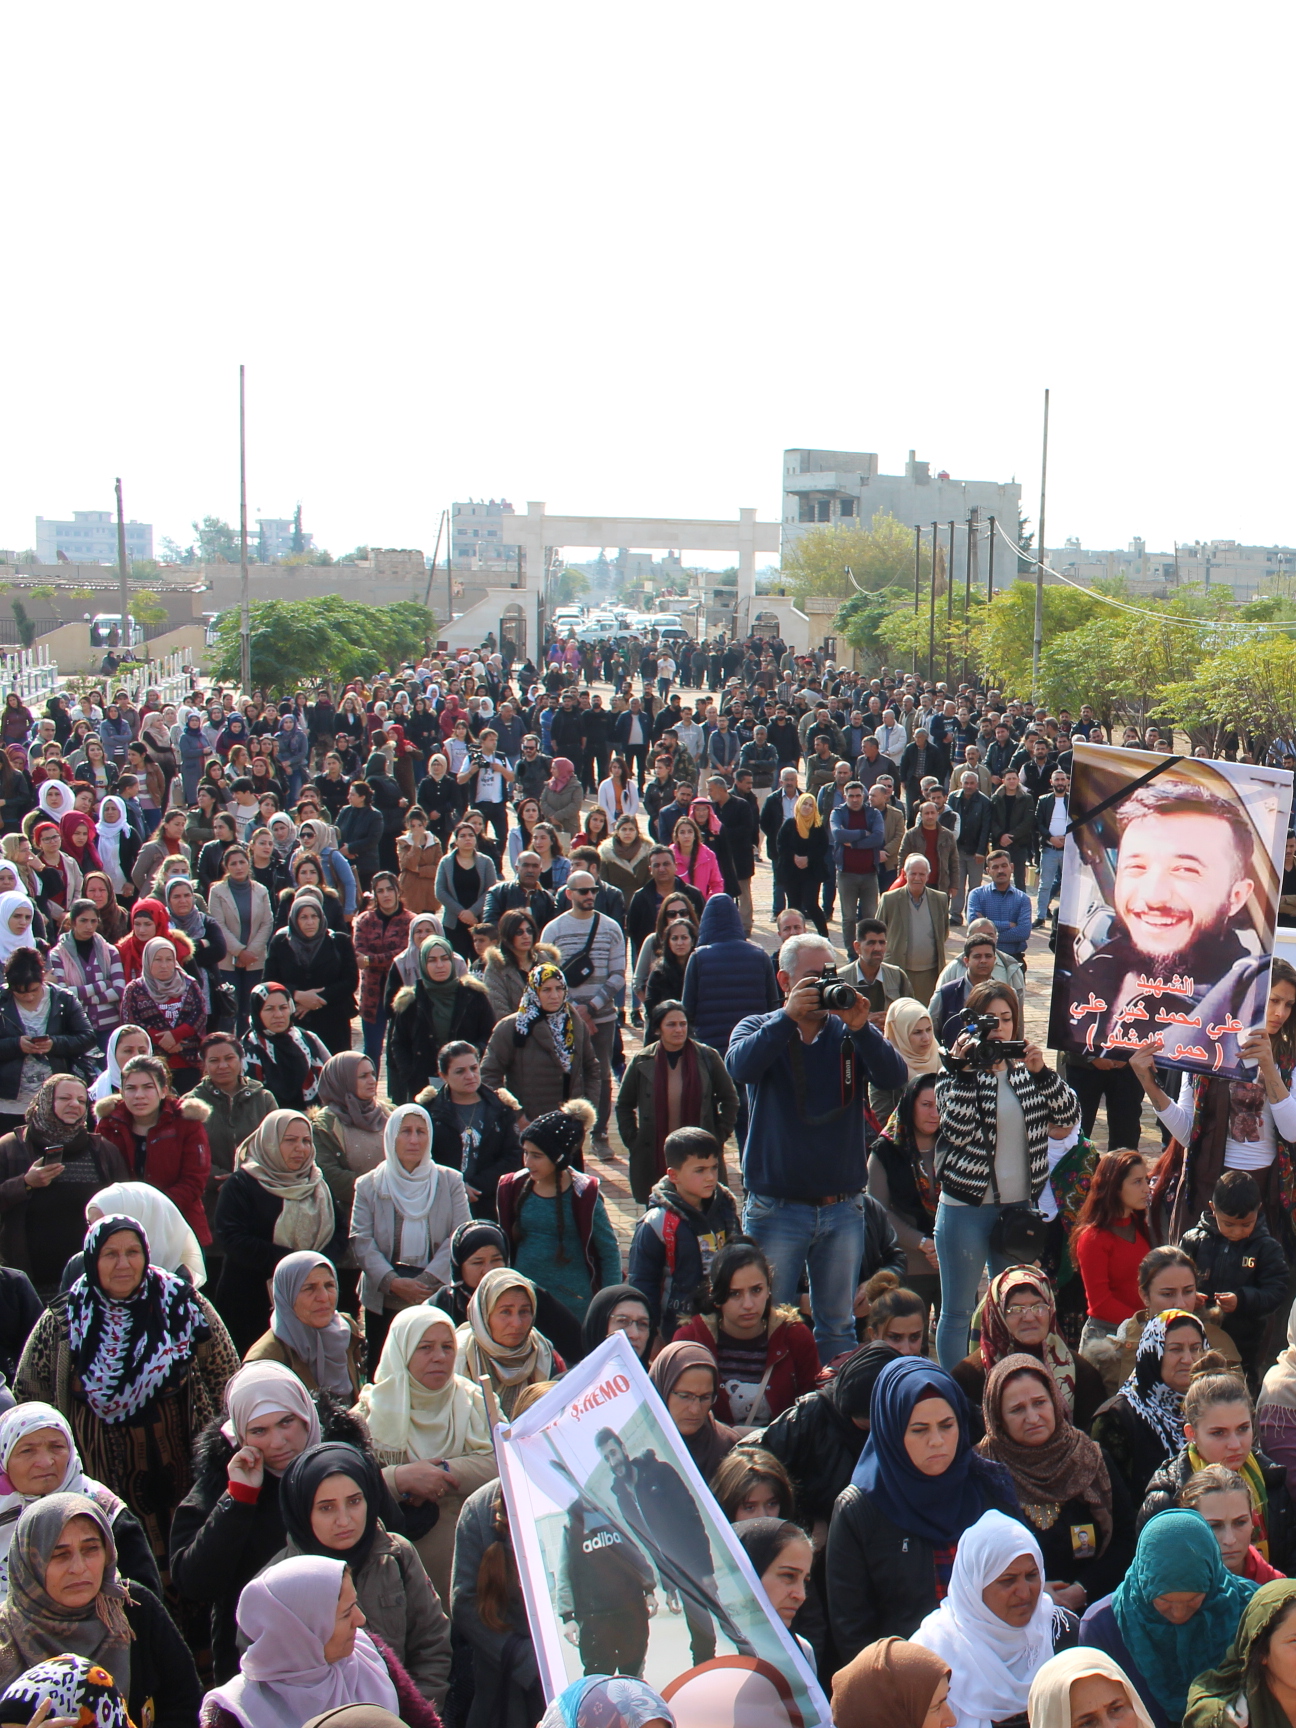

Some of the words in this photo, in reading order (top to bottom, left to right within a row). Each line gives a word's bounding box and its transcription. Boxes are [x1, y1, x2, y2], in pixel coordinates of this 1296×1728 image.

[1136, 973, 1194, 997] الشهيد
[1070, 992, 1107, 1018] علي
[1115, 1000, 1149, 1022] خير
[1155, 1007, 1202, 1028] محمد
[1206, 1013, 1244, 1040] علي
